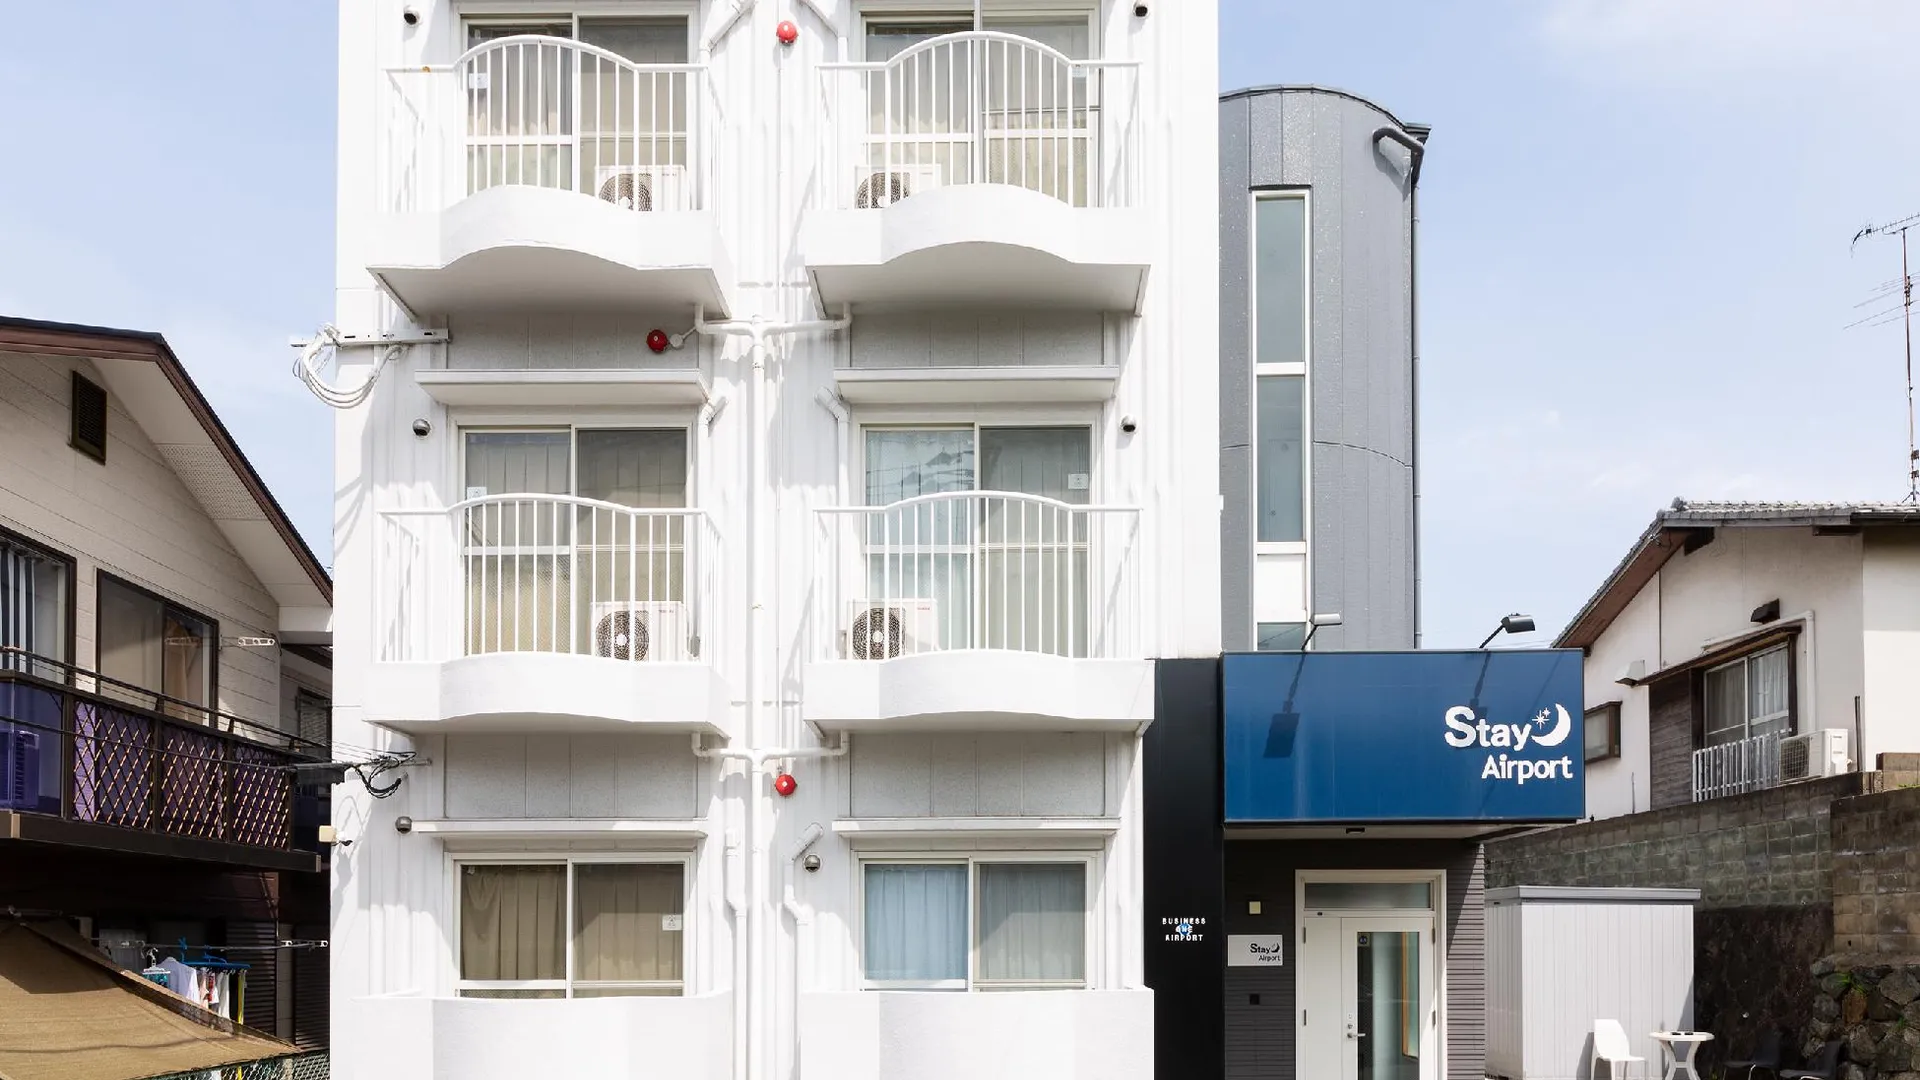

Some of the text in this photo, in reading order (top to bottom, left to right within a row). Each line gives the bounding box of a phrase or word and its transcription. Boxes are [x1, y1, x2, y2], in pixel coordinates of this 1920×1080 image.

[1444, 705, 1532, 751] Stay
[1481, 754, 1573, 784] Airport
[1250, 943, 1271, 954] Stay
